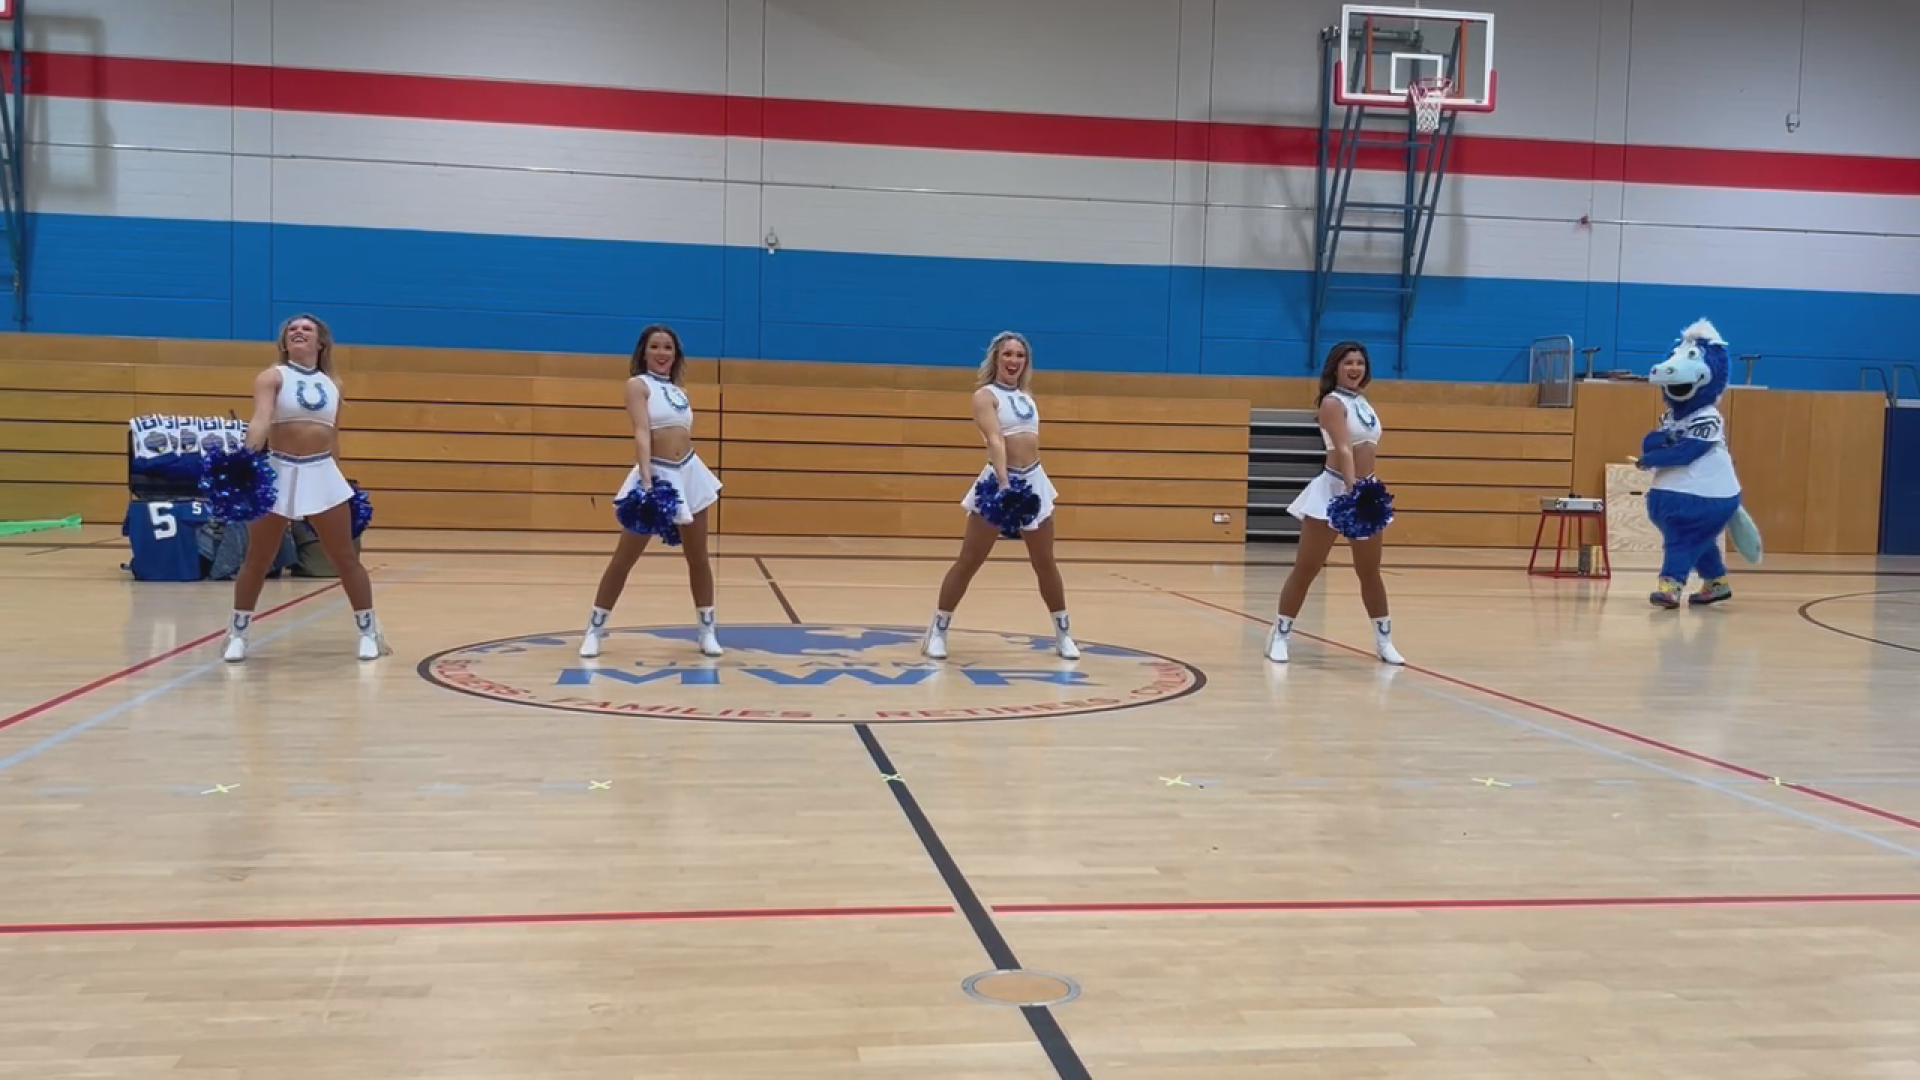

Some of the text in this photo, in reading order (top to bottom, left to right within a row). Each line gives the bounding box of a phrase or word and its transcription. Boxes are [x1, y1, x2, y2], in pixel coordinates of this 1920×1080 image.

[148, 502, 177, 540] 5
[554, 668, 1104, 686] MWR
[551, 696, 813, 717] FAMILIES
